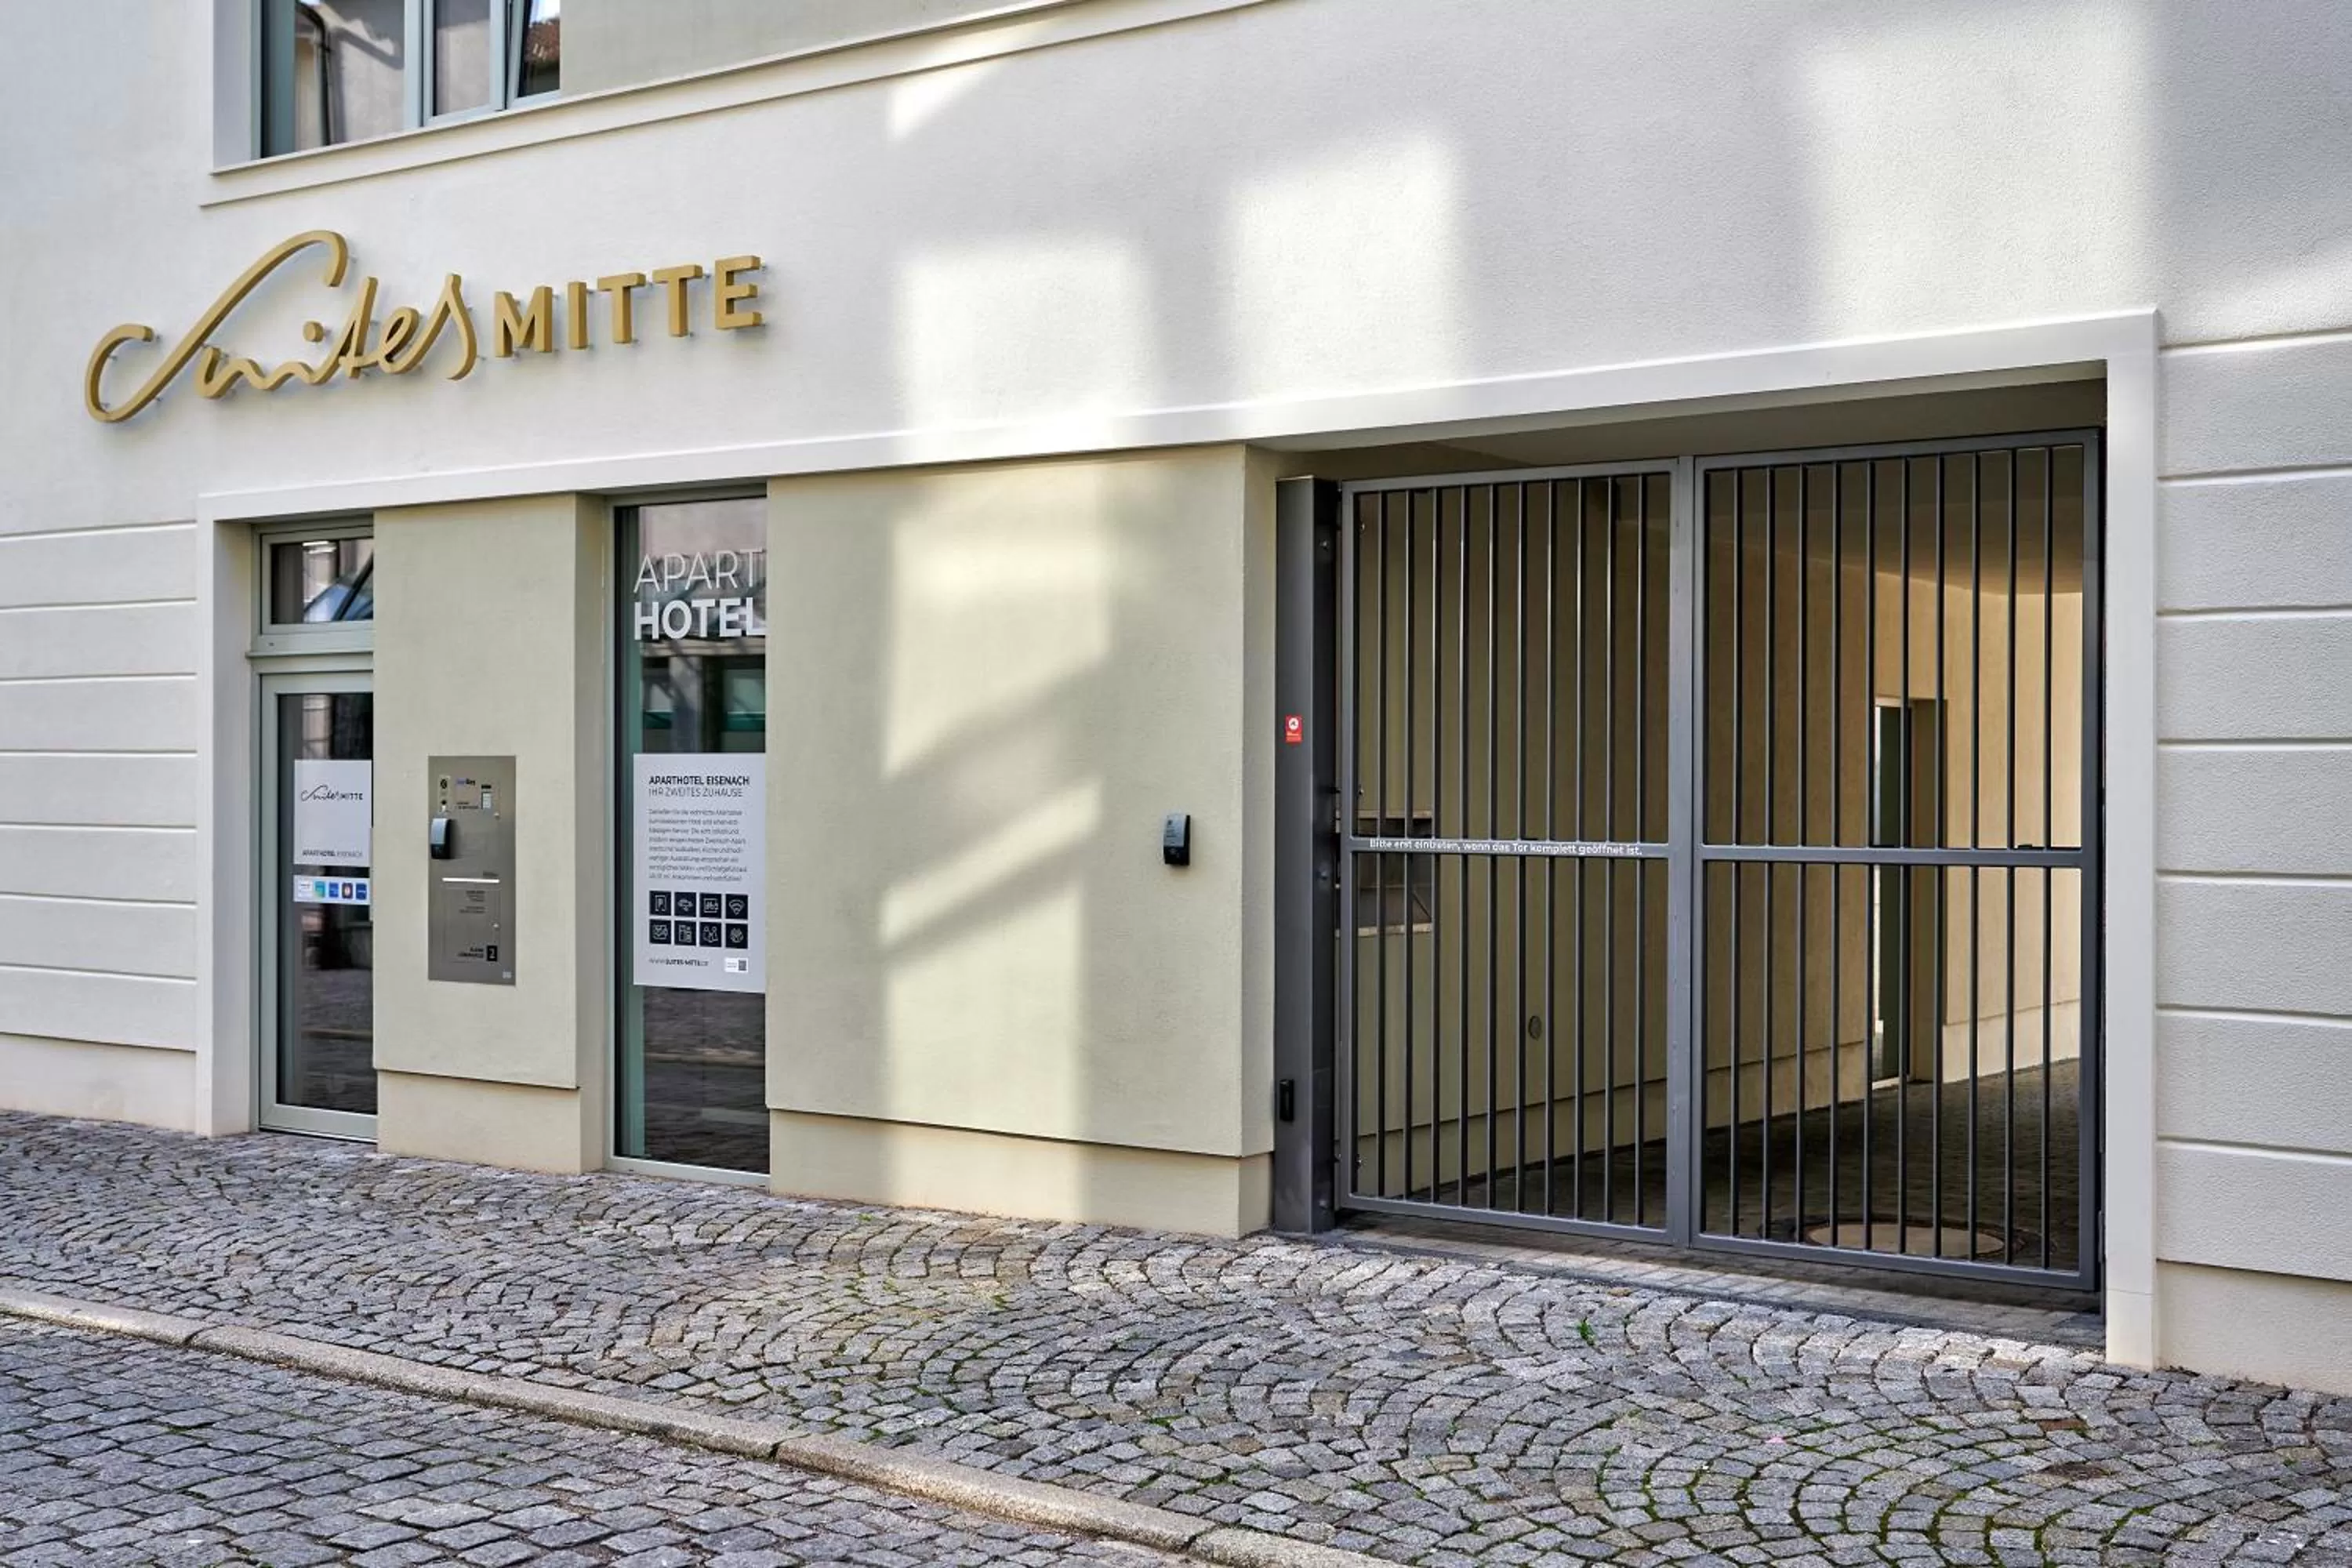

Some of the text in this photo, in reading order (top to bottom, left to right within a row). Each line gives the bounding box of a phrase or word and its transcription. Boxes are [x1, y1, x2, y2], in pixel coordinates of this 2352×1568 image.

[495, 255, 767, 358] MITTE
[633, 546, 763, 593] APART
[633, 597, 765, 641] HOTEL
[648, 775, 750, 786] APARTHOTEL EISENACH
[648, 786, 743, 797] IHR ZWEITES ZUHAUSE
[1370, 838, 1642, 855] Bitte erst eintreten, wenn das Tor komplett geöffnet ist.
